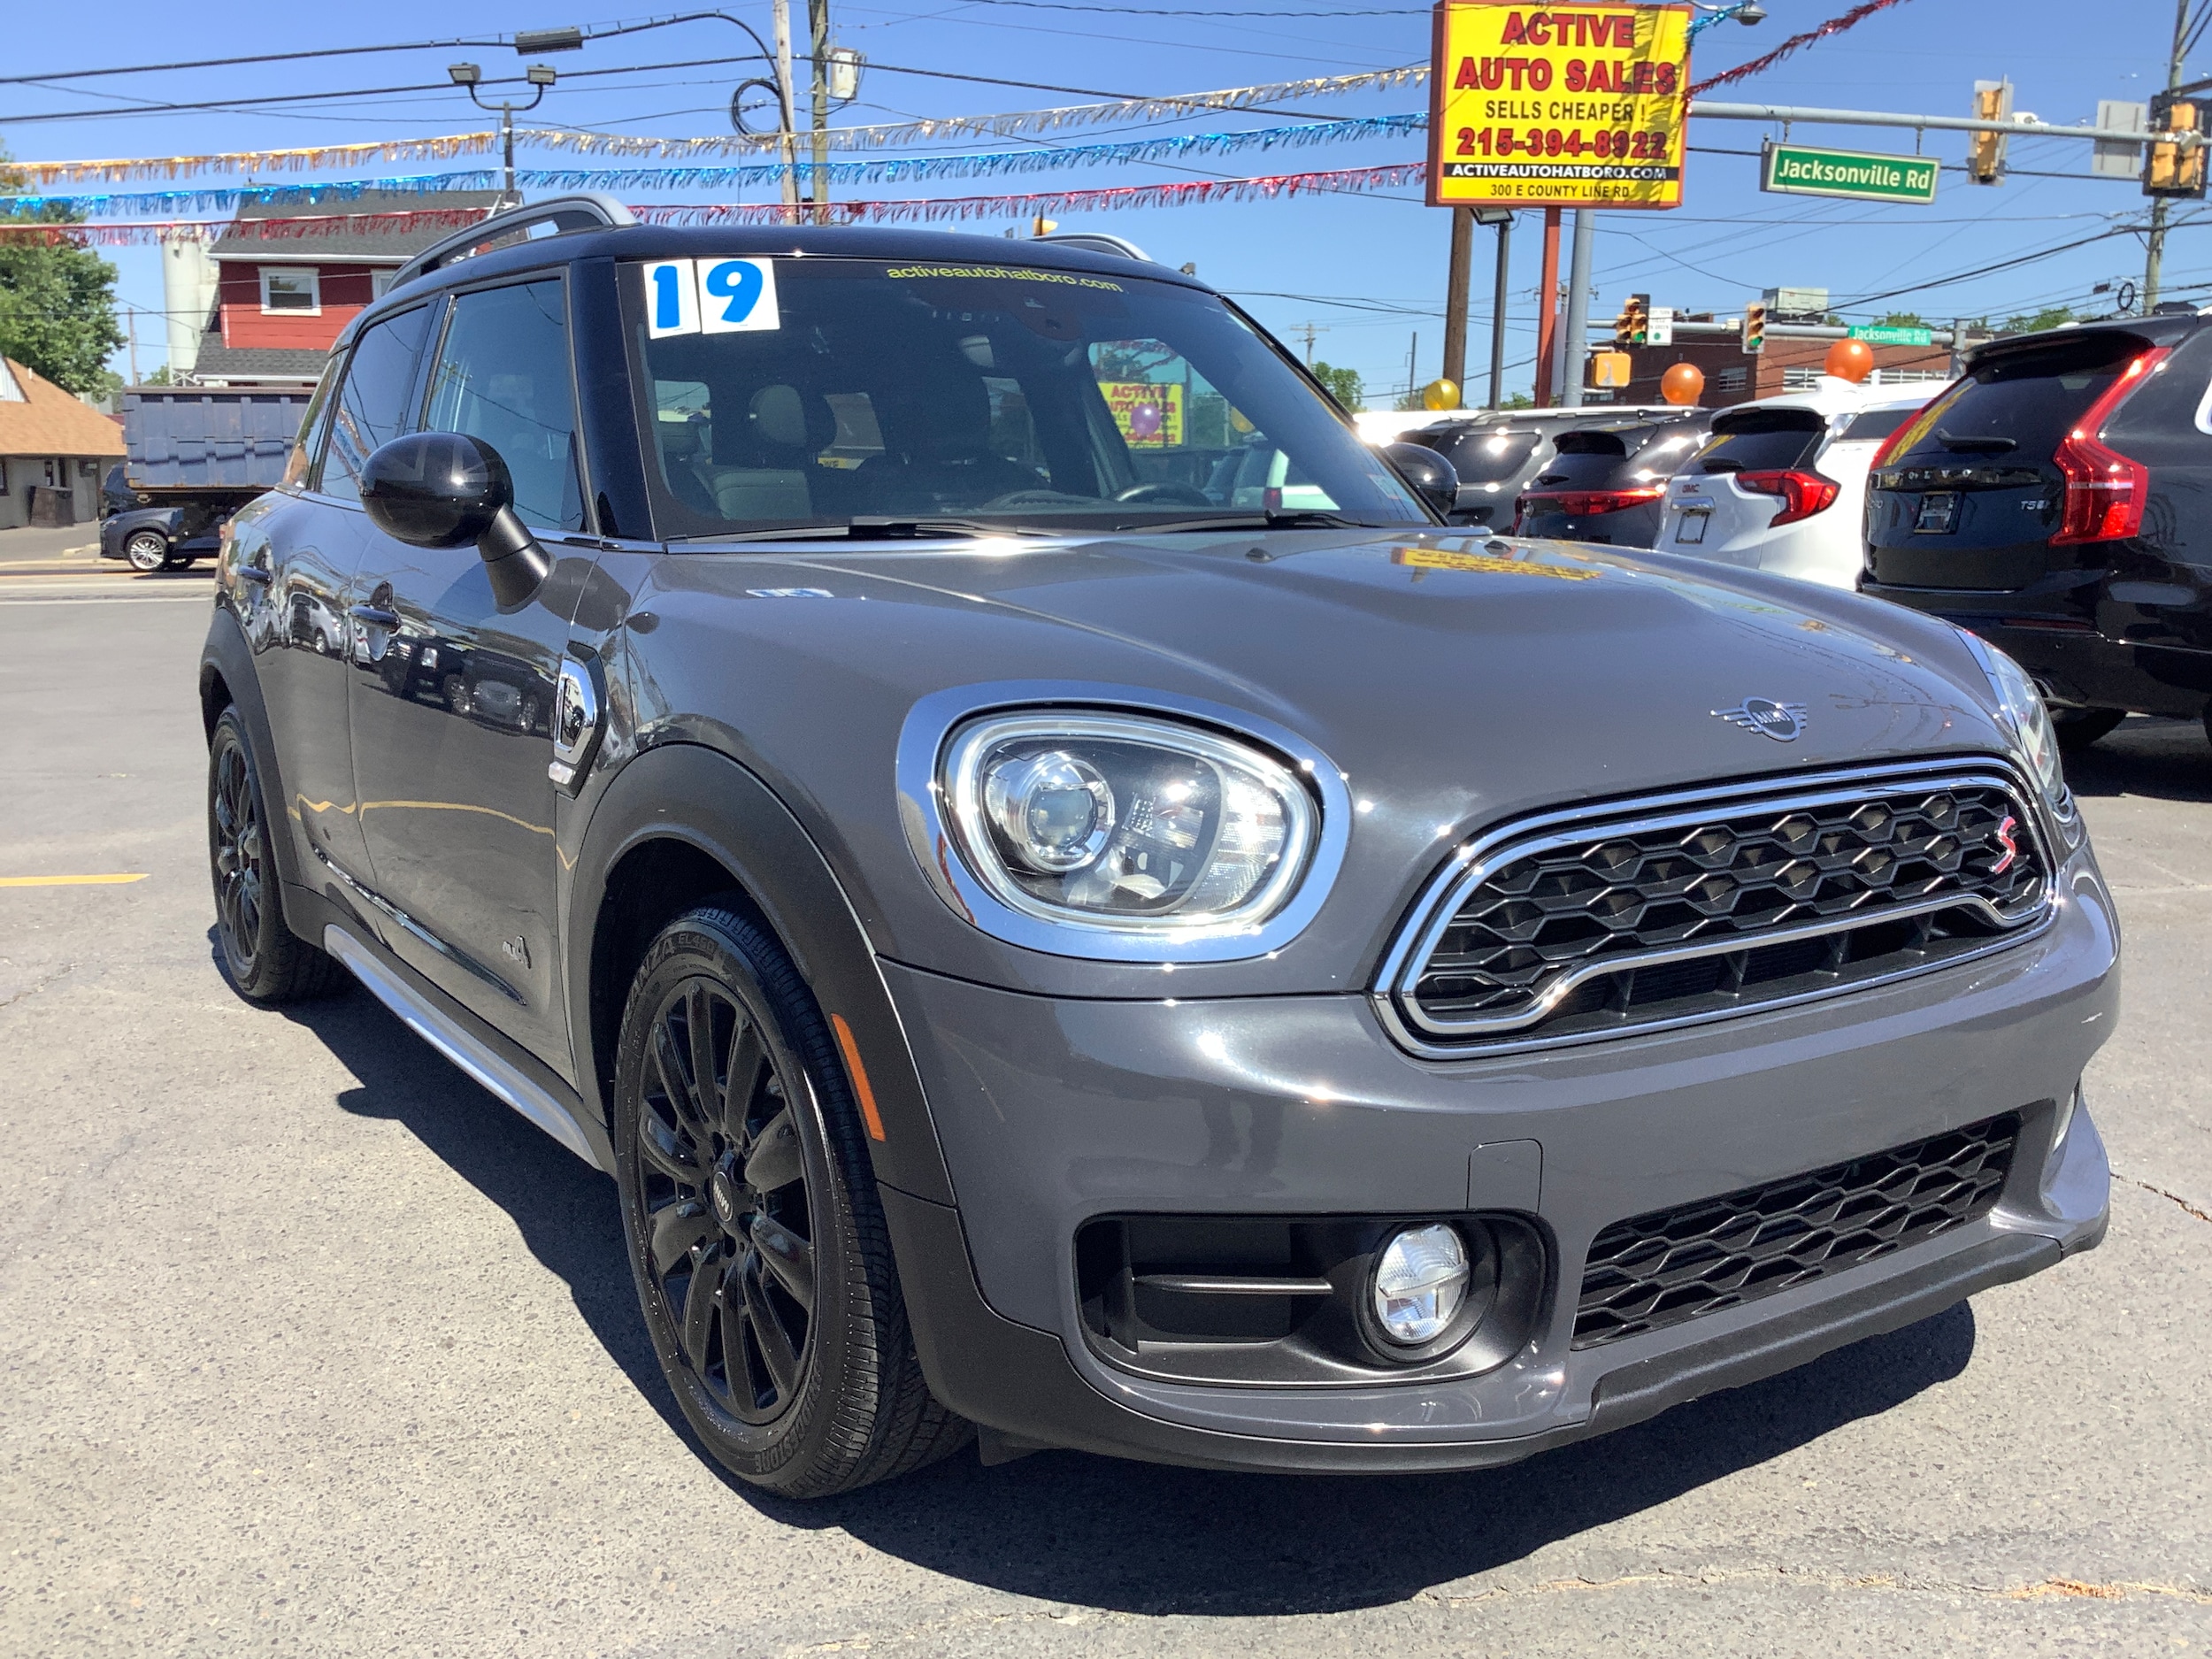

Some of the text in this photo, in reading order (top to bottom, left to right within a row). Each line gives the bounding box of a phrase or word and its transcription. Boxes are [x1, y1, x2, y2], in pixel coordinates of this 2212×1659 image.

[1501, 12, 1635, 48] ACTIVE
[1454, 57, 1676, 95] AUTO SALES
[1486, 100, 1541, 119] SELLS
[1549, 102, 1633, 121] CHEAPER
[1456, 127, 1667, 159] 215-394-8922
[1451, 165, 1667, 180] ACTIVEAUTOHATBORO.COM
[1778, 158, 1931, 189] Jacksonville Rd
[1491, 184, 1630, 197] 300 E COUNTY LINE RD
[887, 265, 1124, 293] activeautohatboro.com
[653, 260, 764, 329] 19
[1853, 327, 1927, 343] Jacksonville Rd
